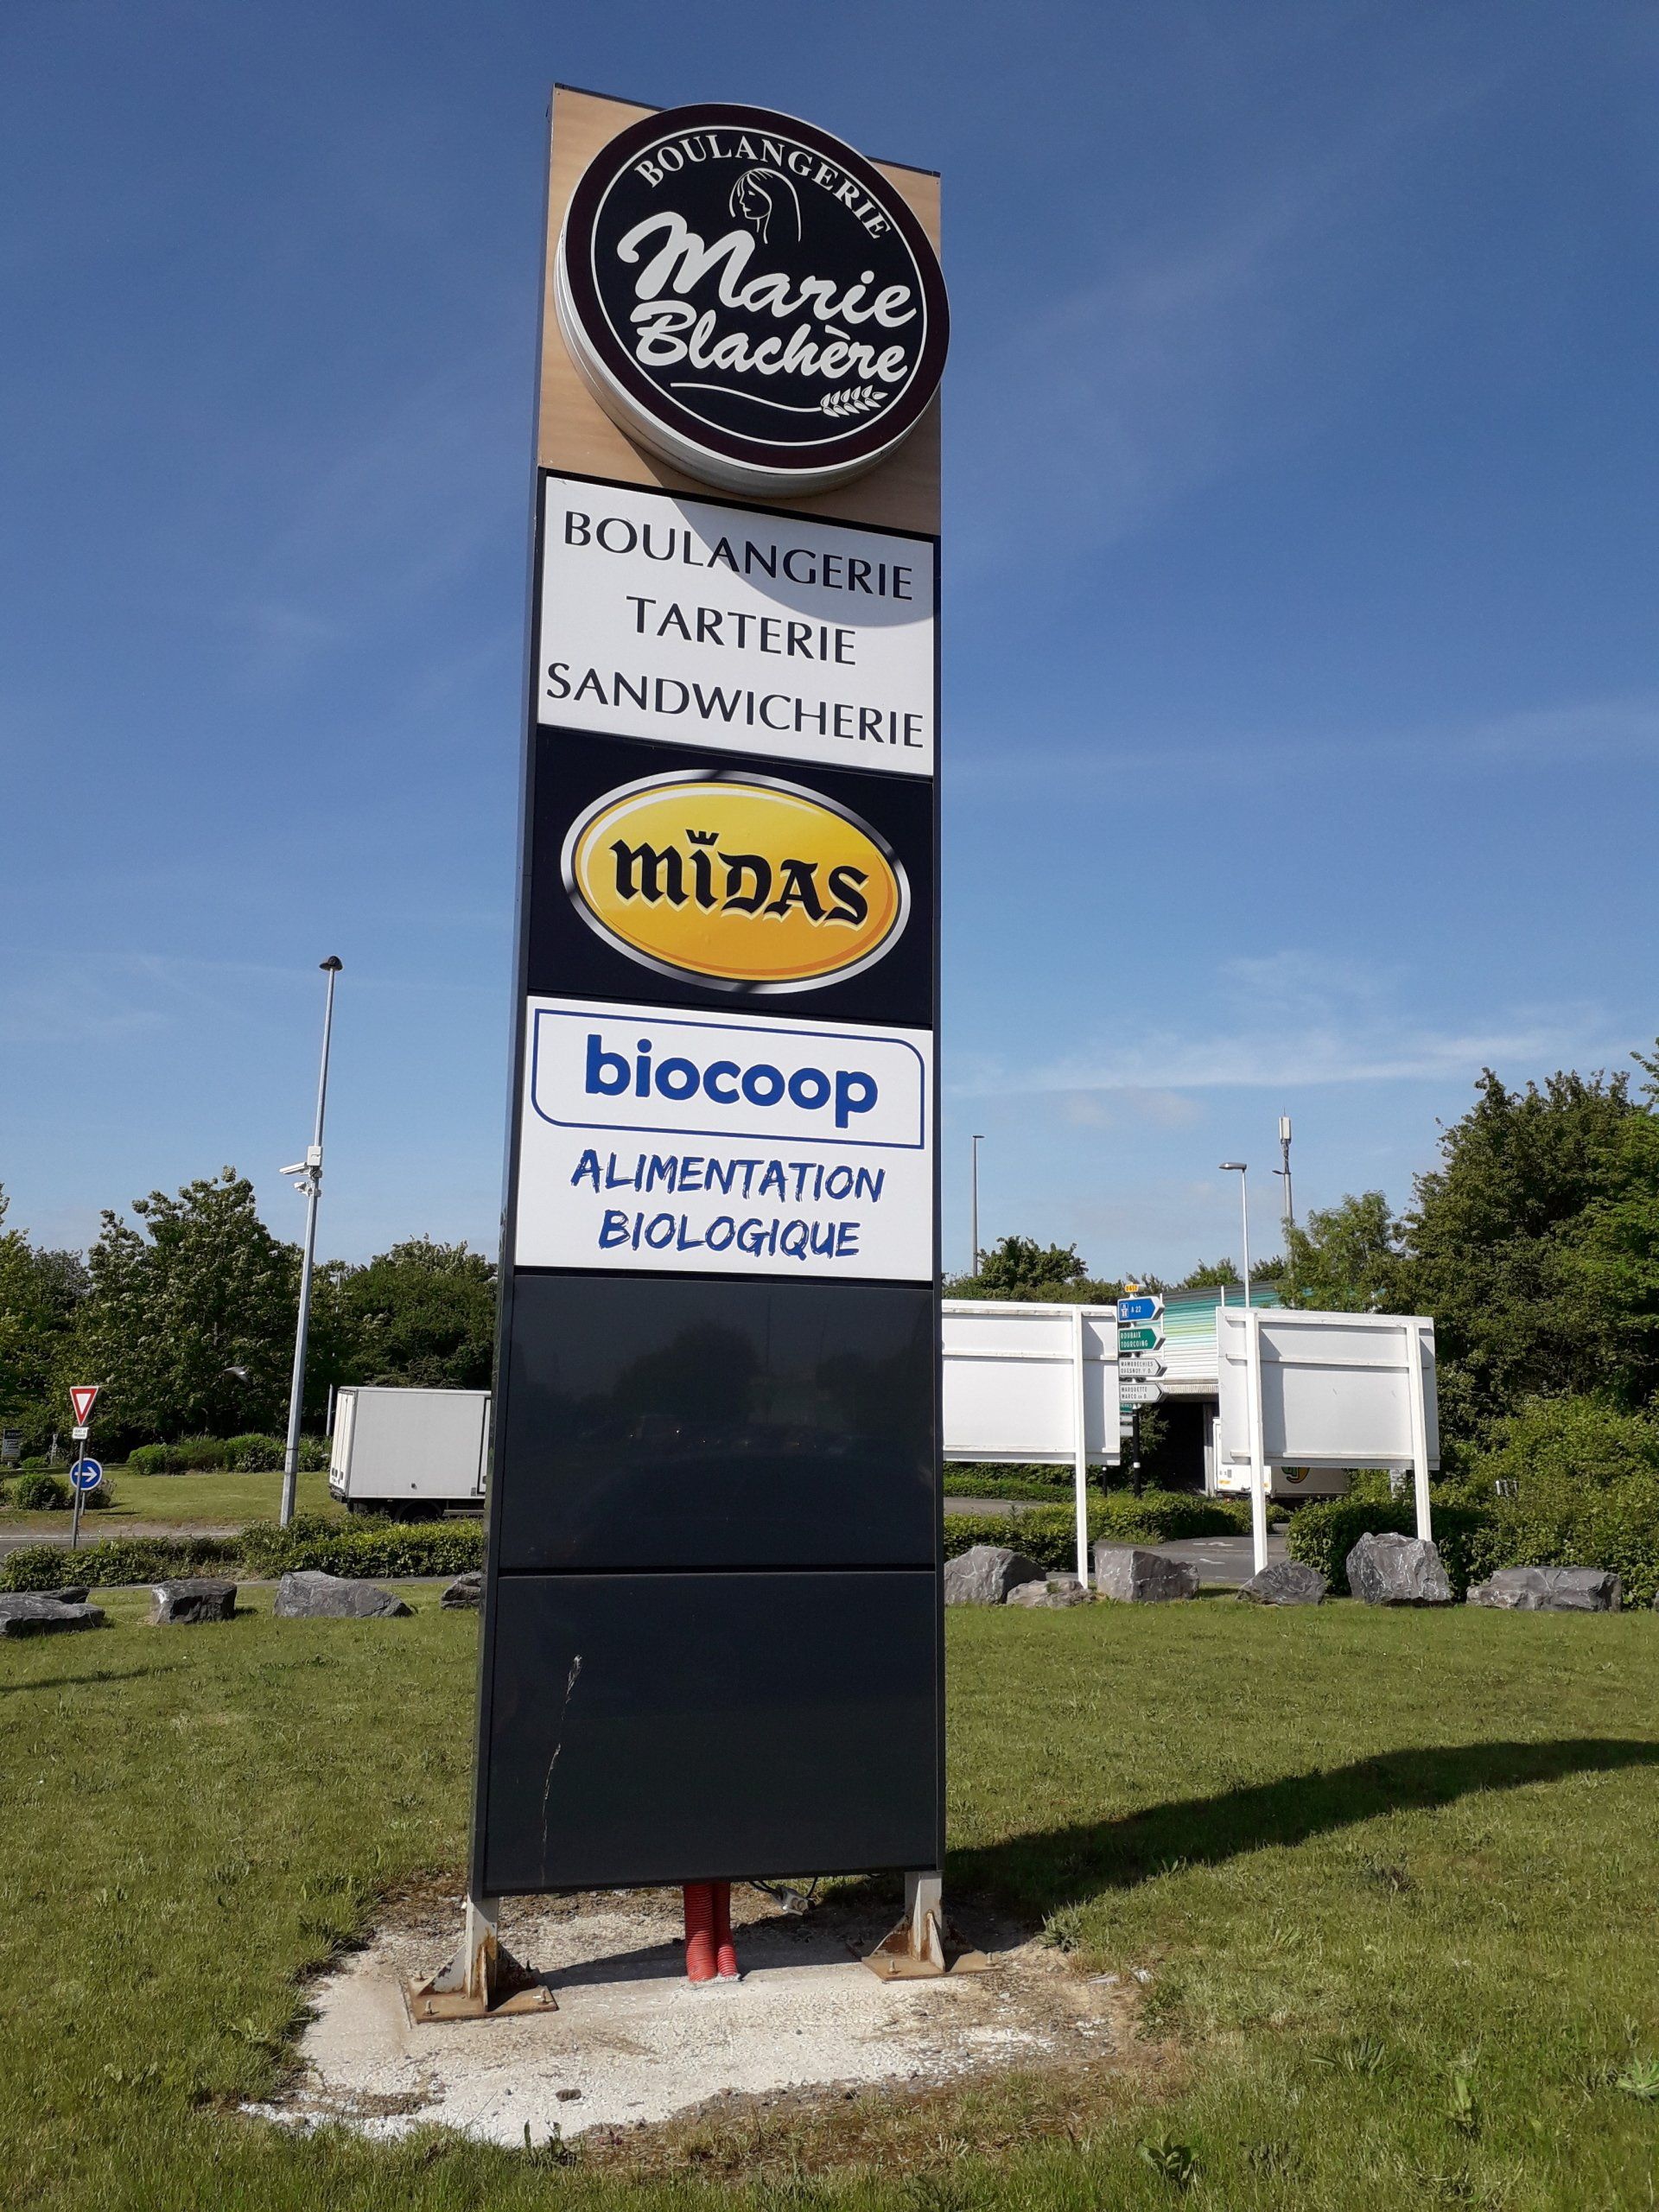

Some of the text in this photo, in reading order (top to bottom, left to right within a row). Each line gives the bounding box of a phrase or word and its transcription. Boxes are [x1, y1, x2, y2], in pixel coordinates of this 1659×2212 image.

[634, 133, 890, 240] BOULANGERIE
[617, 211, 917, 328] Marie
[630, 299, 908, 382] Blachère
[564, 511, 912, 601] BOULANGERIE
[626, 595, 856, 665] TARTERIE
[546, 662, 924, 748] SANDWICHERIE
[585, 1033, 878, 1128] biocoop
[570, 1148, 887, 1203] ALIMENTATION
[598, 1210, 861, 1262] BIOLOGIQUE
[1120, 1331, 1141, 1339] ROUBAIX
